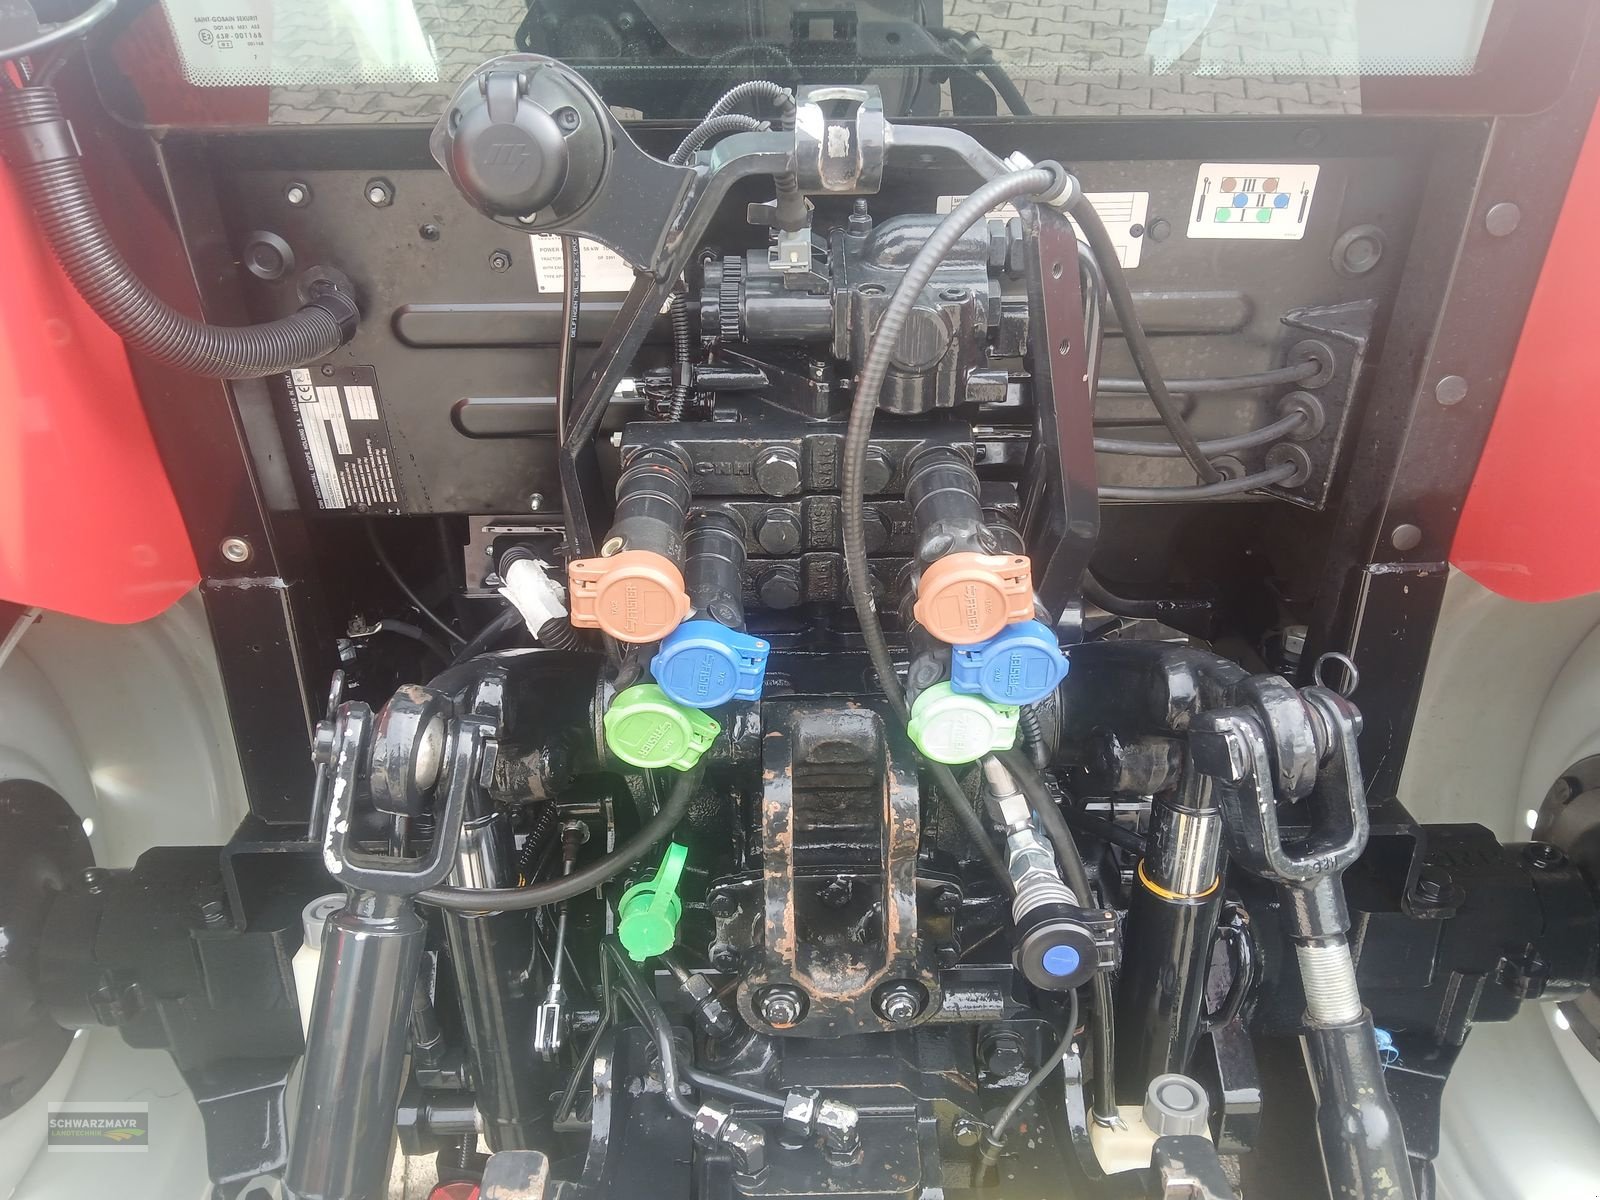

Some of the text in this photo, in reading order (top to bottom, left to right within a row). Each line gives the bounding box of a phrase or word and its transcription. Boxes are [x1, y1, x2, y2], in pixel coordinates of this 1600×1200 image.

[201, 32, 211, 41] E2
[284, 374, 293, 388] ITALY
[290, 397, 299, 412] MADE
[298, 428, 310, 450] HOLDING
[303, 451, 315, 471] EUROPE
[694, 460, 750, 476] CNH
